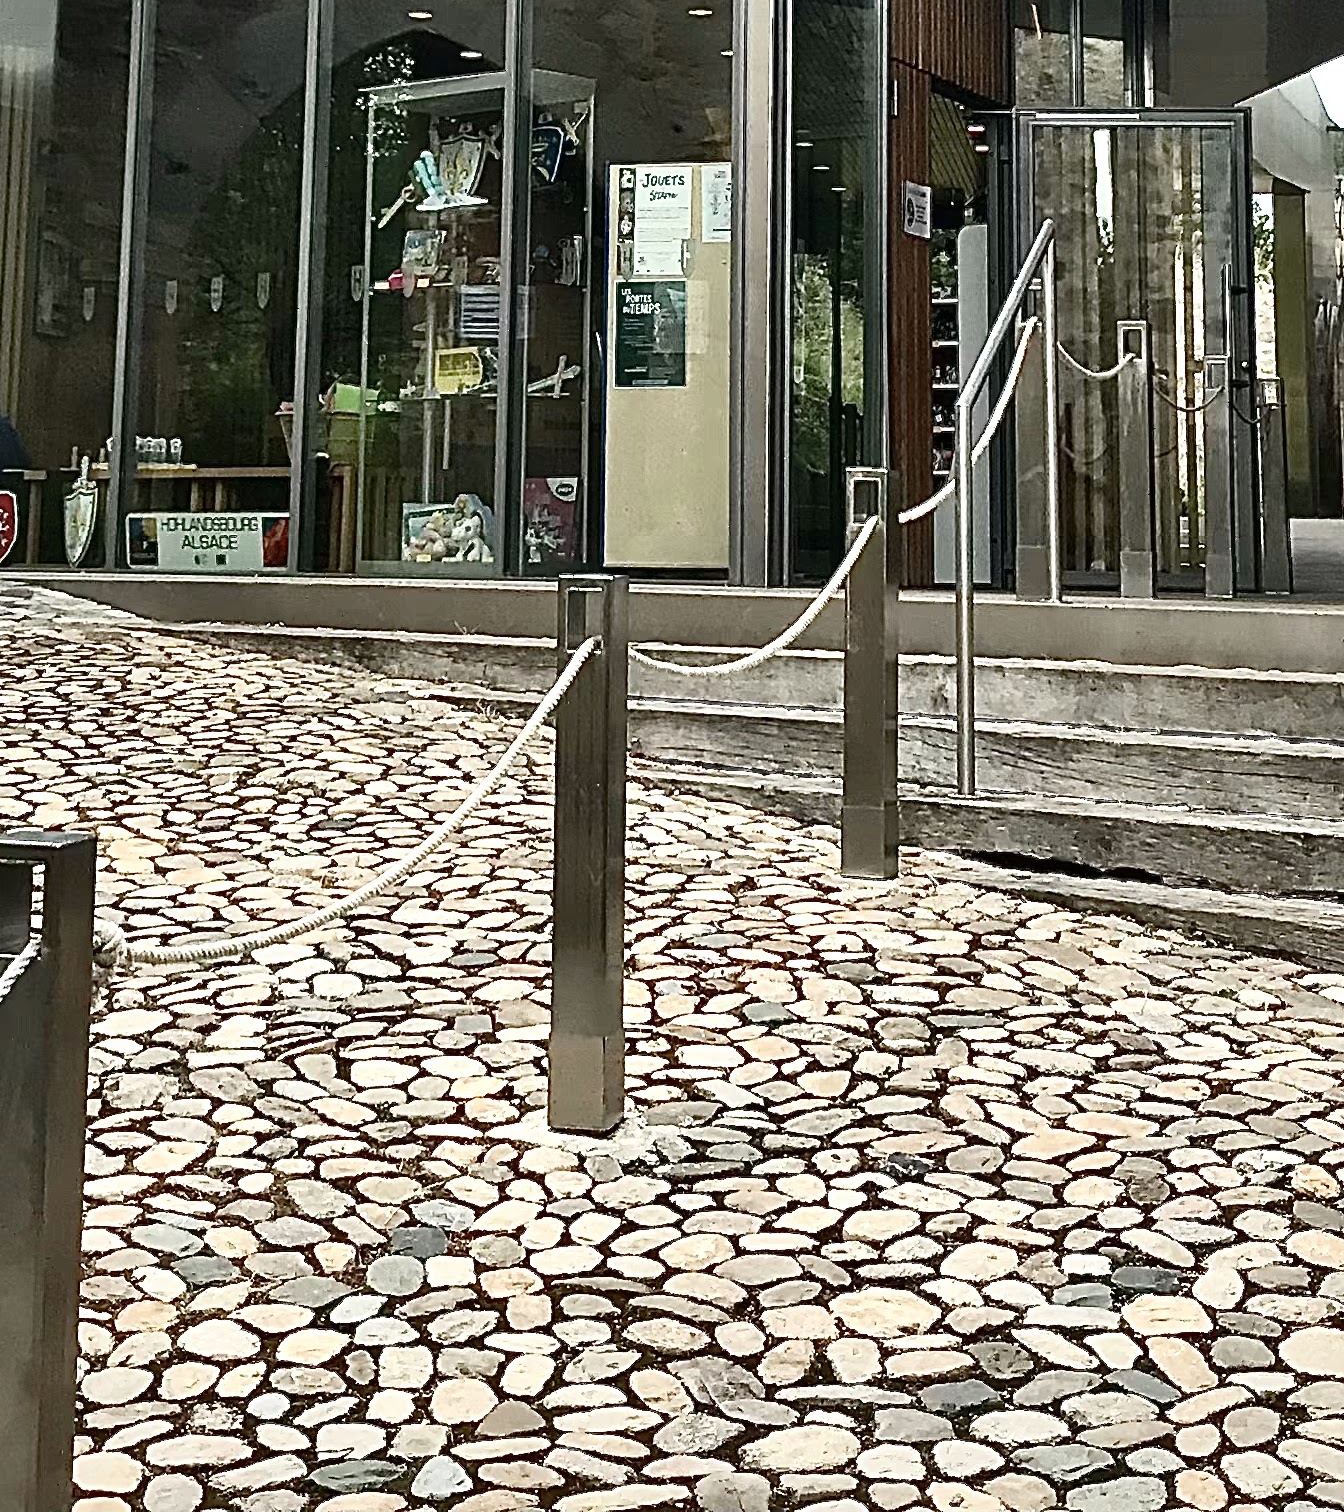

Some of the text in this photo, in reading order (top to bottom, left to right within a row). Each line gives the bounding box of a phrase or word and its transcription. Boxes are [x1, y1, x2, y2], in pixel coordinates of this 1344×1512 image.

[642, 173, 686, 188] JOUETS
[629, 303, 661, 315] TEMPS
[160, 516, 259, 532] HOHLANDSBOURG
[181, 534, 239, 550] ALSACE
